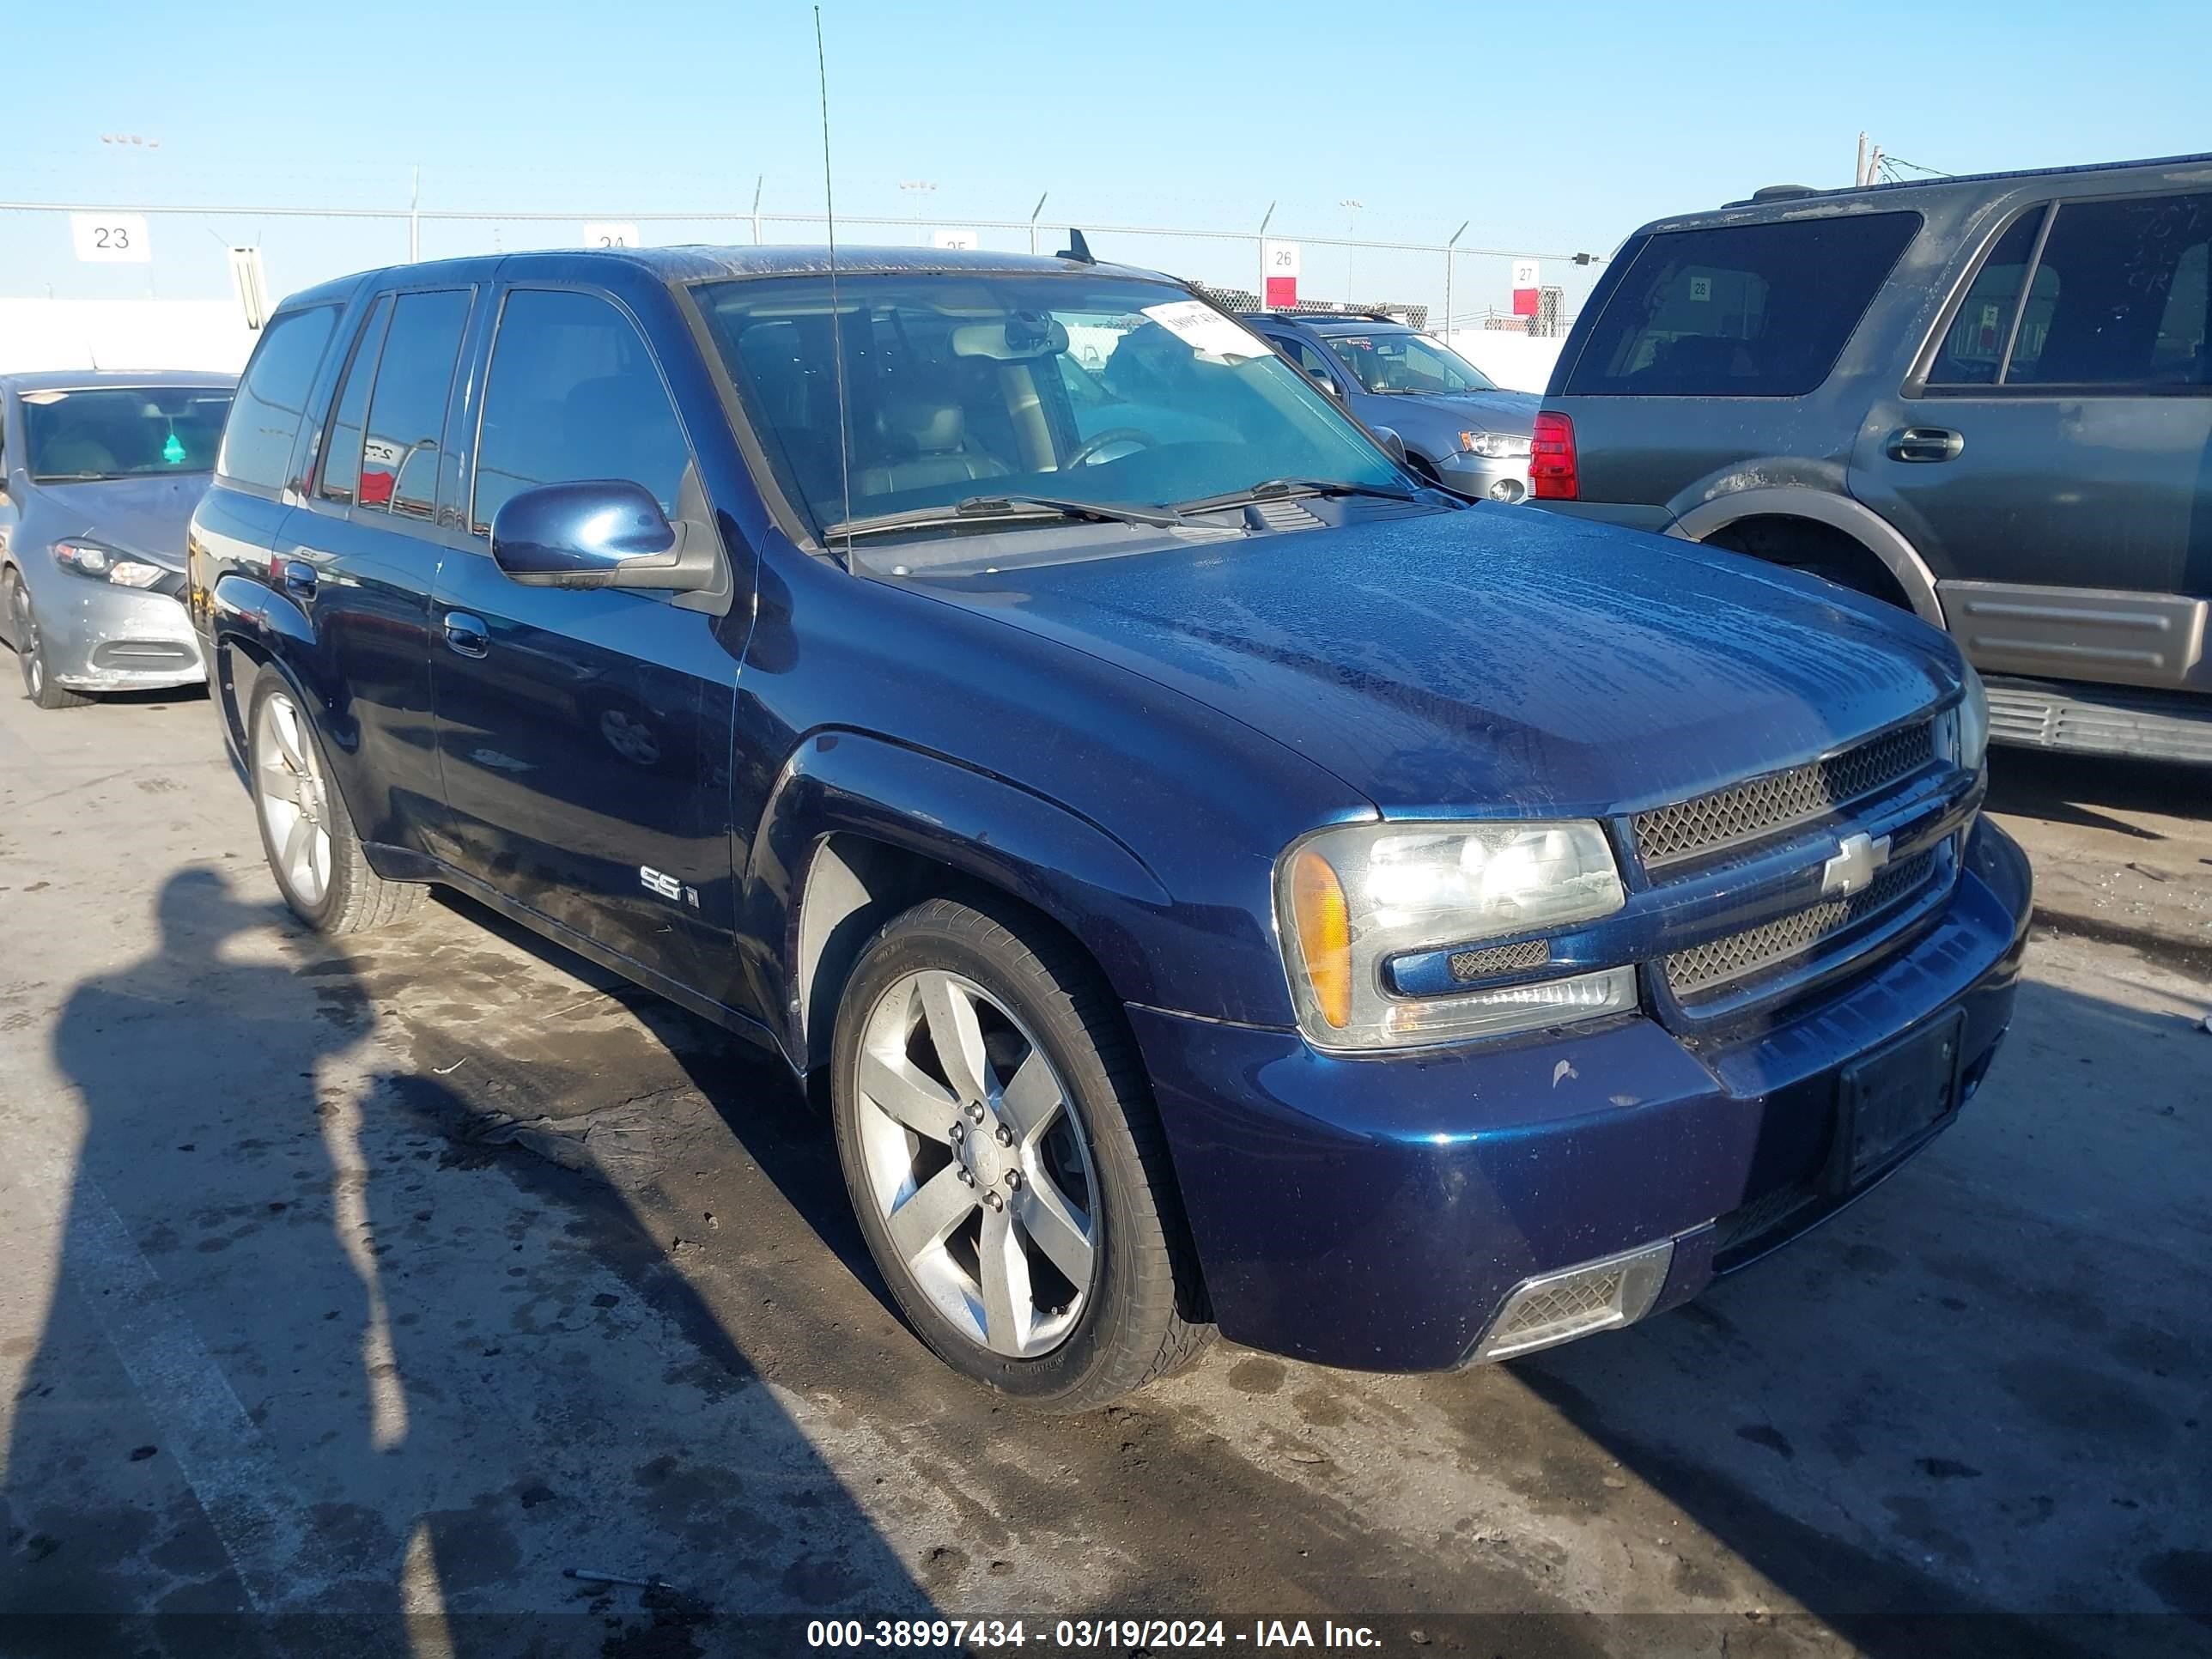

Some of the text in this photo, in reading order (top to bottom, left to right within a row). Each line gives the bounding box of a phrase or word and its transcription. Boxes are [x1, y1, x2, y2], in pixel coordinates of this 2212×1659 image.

[94, 228, 129, 249] 23
[1276, 251, 1291, 265] 26
[1519, 268, 1533, 281] 27
[1695, 283, 1705, 295] 28
[640, 866, 681, 902] SS
